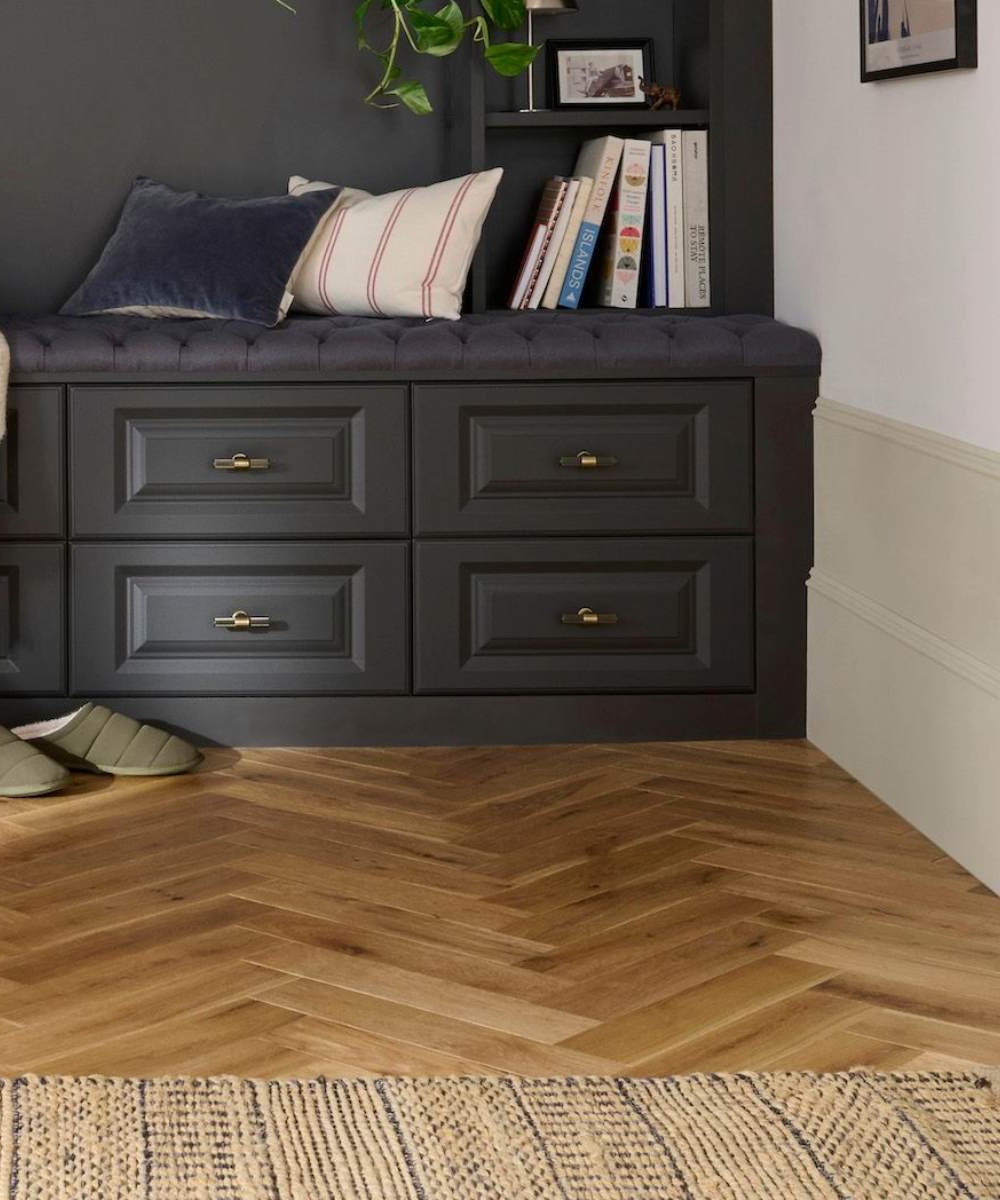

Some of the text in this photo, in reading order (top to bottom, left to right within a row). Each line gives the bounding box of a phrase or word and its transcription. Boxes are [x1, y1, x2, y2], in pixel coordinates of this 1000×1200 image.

[593, 155, 614, 211] KINFOLK
[569, 227, 595, 290] ISLANDS
[690, 225, 698, 263] TO STAY
[698, 225, 707, 300] REMOTE PLACES
